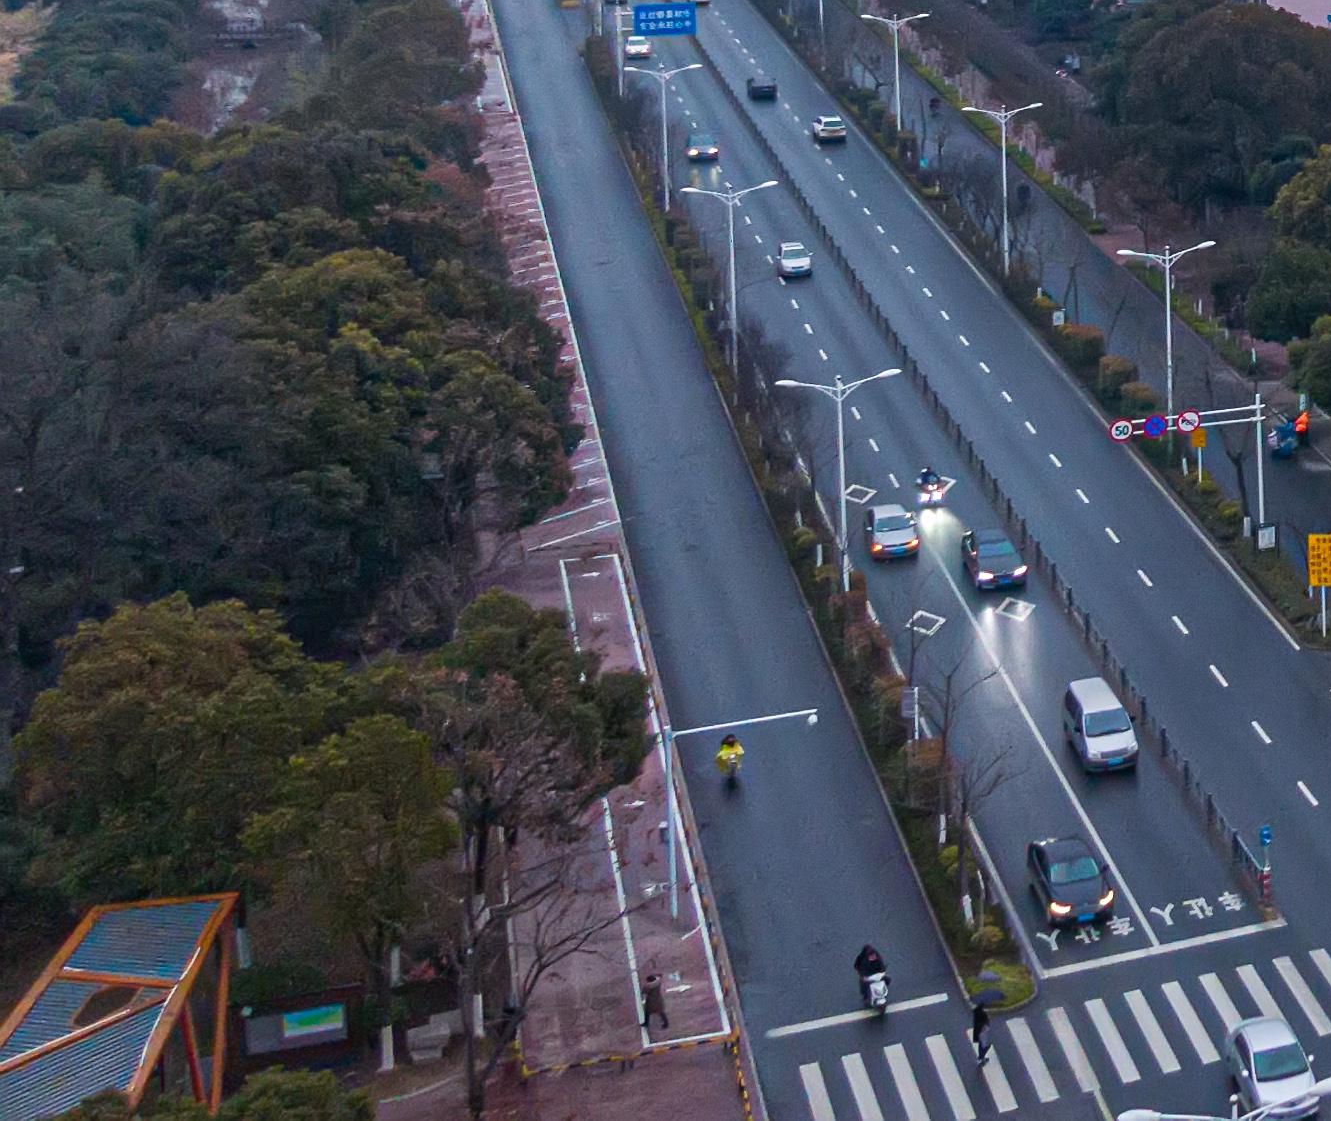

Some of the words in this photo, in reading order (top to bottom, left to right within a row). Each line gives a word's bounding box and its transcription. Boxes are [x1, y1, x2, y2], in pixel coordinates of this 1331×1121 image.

[1115, 425, 1129, 436] 50
[1149, 890, 1245, 926] 车让人
